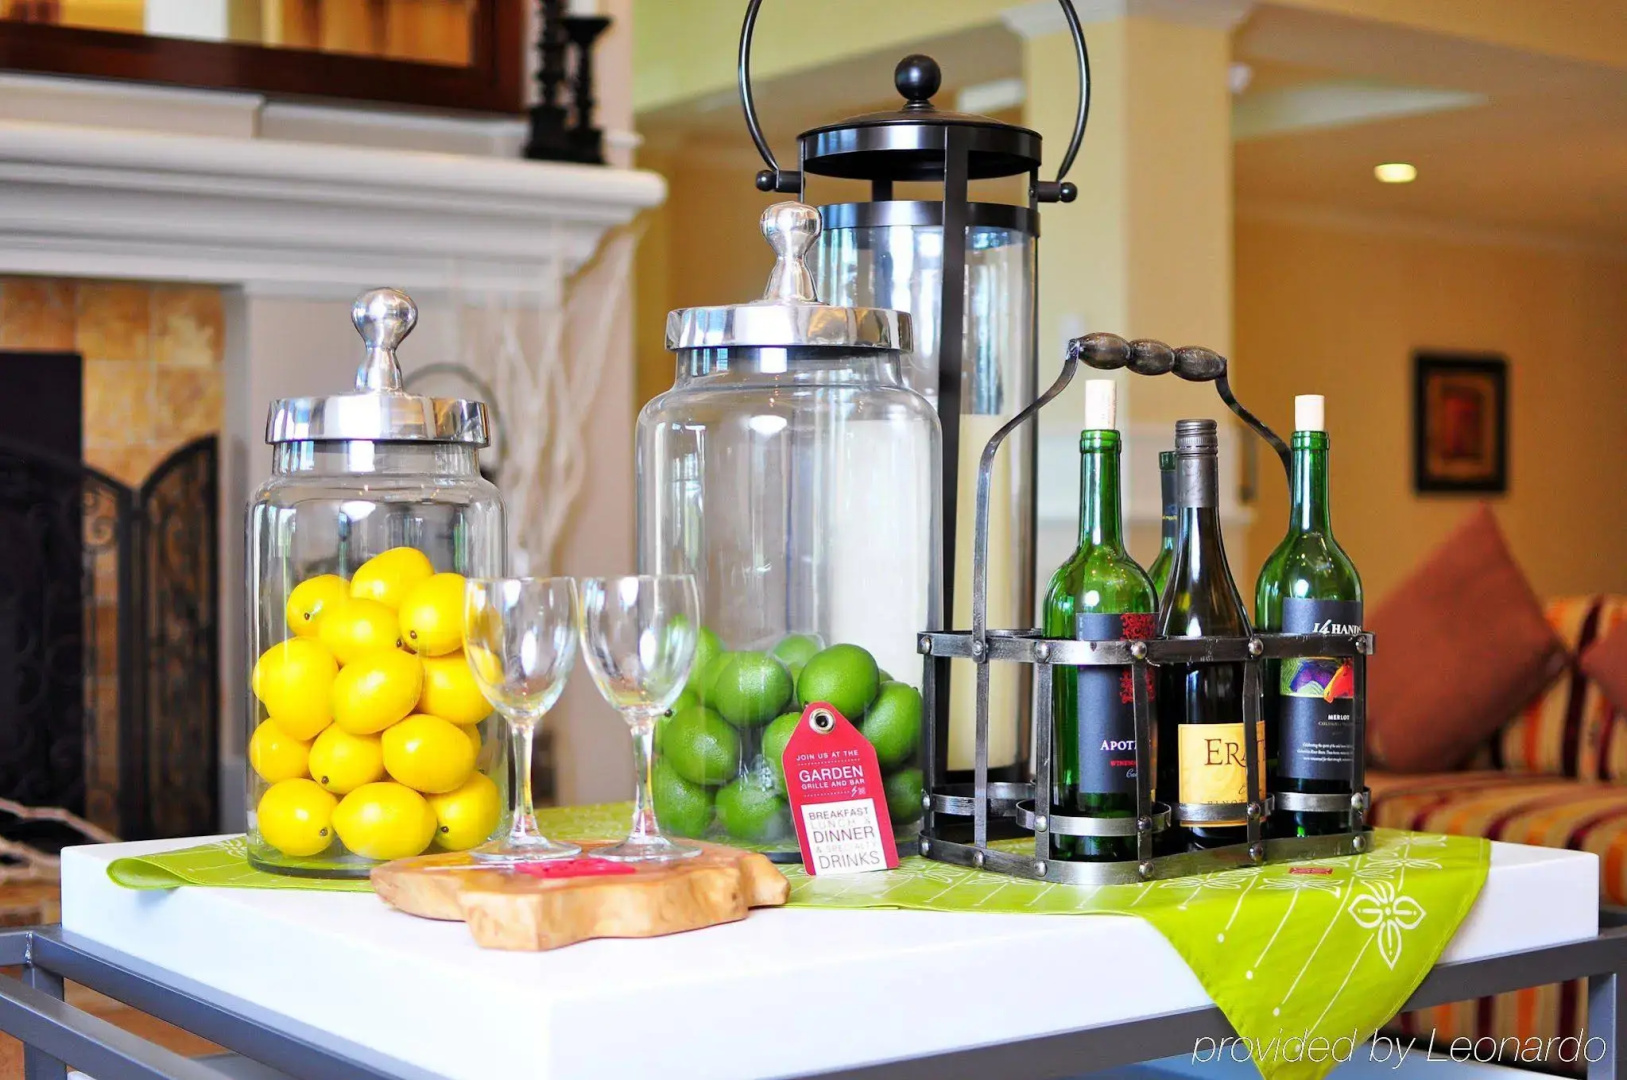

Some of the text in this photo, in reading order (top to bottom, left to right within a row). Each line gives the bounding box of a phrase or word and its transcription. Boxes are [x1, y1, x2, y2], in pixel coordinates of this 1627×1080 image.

[843, 749, 859, 757] THE
[799, 765, 864, 782] GARDEN
[801, 778, 865, 790] GRILLE AND BAR
[808, 806, 869, 821] BREAKFAST
[813, 826, 875, 844] DINNER
[819, 850, 881, 869] DRINKS
